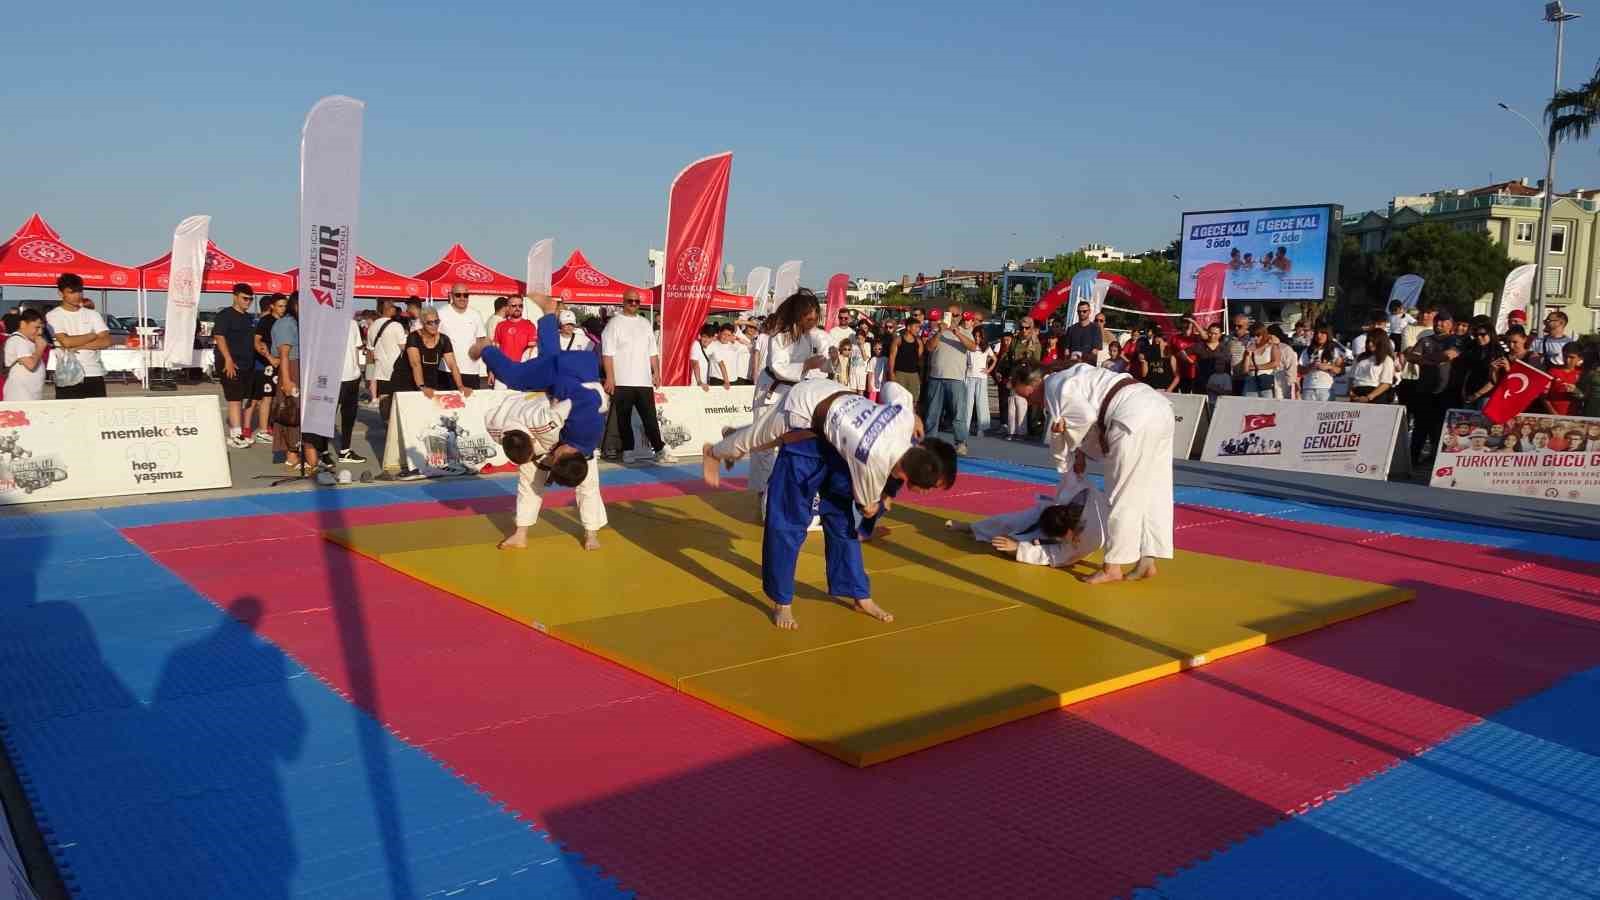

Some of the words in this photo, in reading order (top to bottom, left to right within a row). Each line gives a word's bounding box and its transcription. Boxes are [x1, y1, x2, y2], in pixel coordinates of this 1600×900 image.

[1227, 223, 1248, 235] KAL
[1266, 218, 1294, 232] GECE
[1295, 215, 1318, 230] KAL
[131, 460, 157, 471] hep
[134, 470, 184, 484] yaşımız
